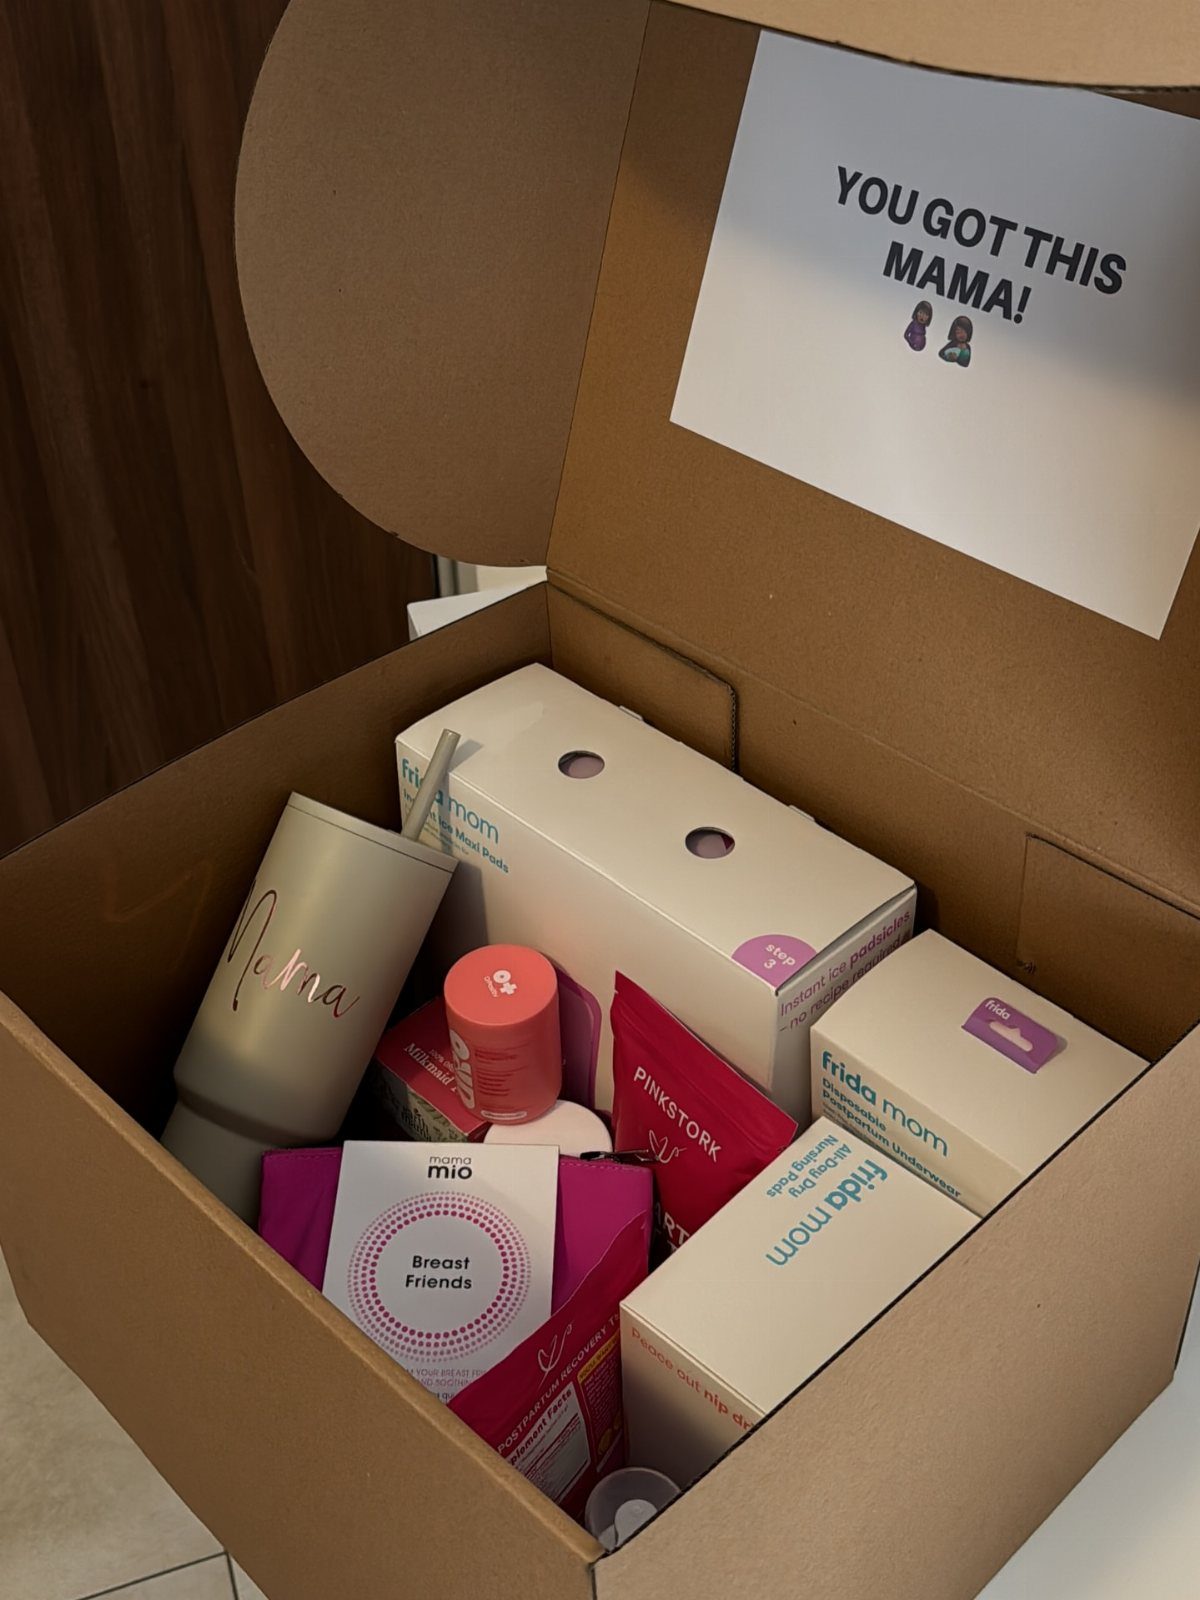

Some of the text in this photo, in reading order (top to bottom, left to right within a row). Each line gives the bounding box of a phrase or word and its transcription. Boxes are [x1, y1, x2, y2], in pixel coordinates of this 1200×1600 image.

[838, 165, 1127, 294] YOU GOT THIS
[883, 241, 1032, 324] MAMA!
[402, 758, 444, 806] fria
[448, 796, 499, 844] mom
[456, 828, 480, 852] Maxi
[482, 846, 509, 874] Pads
[764, 958, 777, 969] 3
[765, 944, 796, 967] step
[780, 911, 911, 1017] Instant ice padsicles
[790, 1011, 807, 1029] no
[810, 978, 849, 1014] recipe
[984, 1000, 1011, 1021] frida
[404, 1042, 455, 1086] Milkmaid
[633, 1066, 722, 1162] PINKSTORK
[822, 1050, 877, 1106] frida
[882, 1098, 948, 1157] mom
[822, 1078, 887, 1132] Disposable
[429, 1156, 472, 1165] mama
[766, 1134, 839, 1198] Nursing Pads
[788, 1143, 852, 1198] All-Day Dry
[822, 1089, 890, 1147] Postpartum
[892, 1141, 962, 1198] Underwear
[427, 1165, 473, 1179] mio
[765, 1159, 888, 1266] frida mom
[405, 1274, 473, 1289] Friends
[412, 1255, 471, 1270] Breast
[436, 1379, 470, 1387] SOOTHIN
[498, 1378, 560, 1454] POSTPARTUM
[560, 1327, 607, 1381] RECOVERY
[547, 1388, 573, 1419] Facts
[631, 1327, 674, 1370] Peace
[677, 1368, 702, 1393] out
[703, 1389, 729, 1415] nip
[732, 1412, 755, 1431] dr
